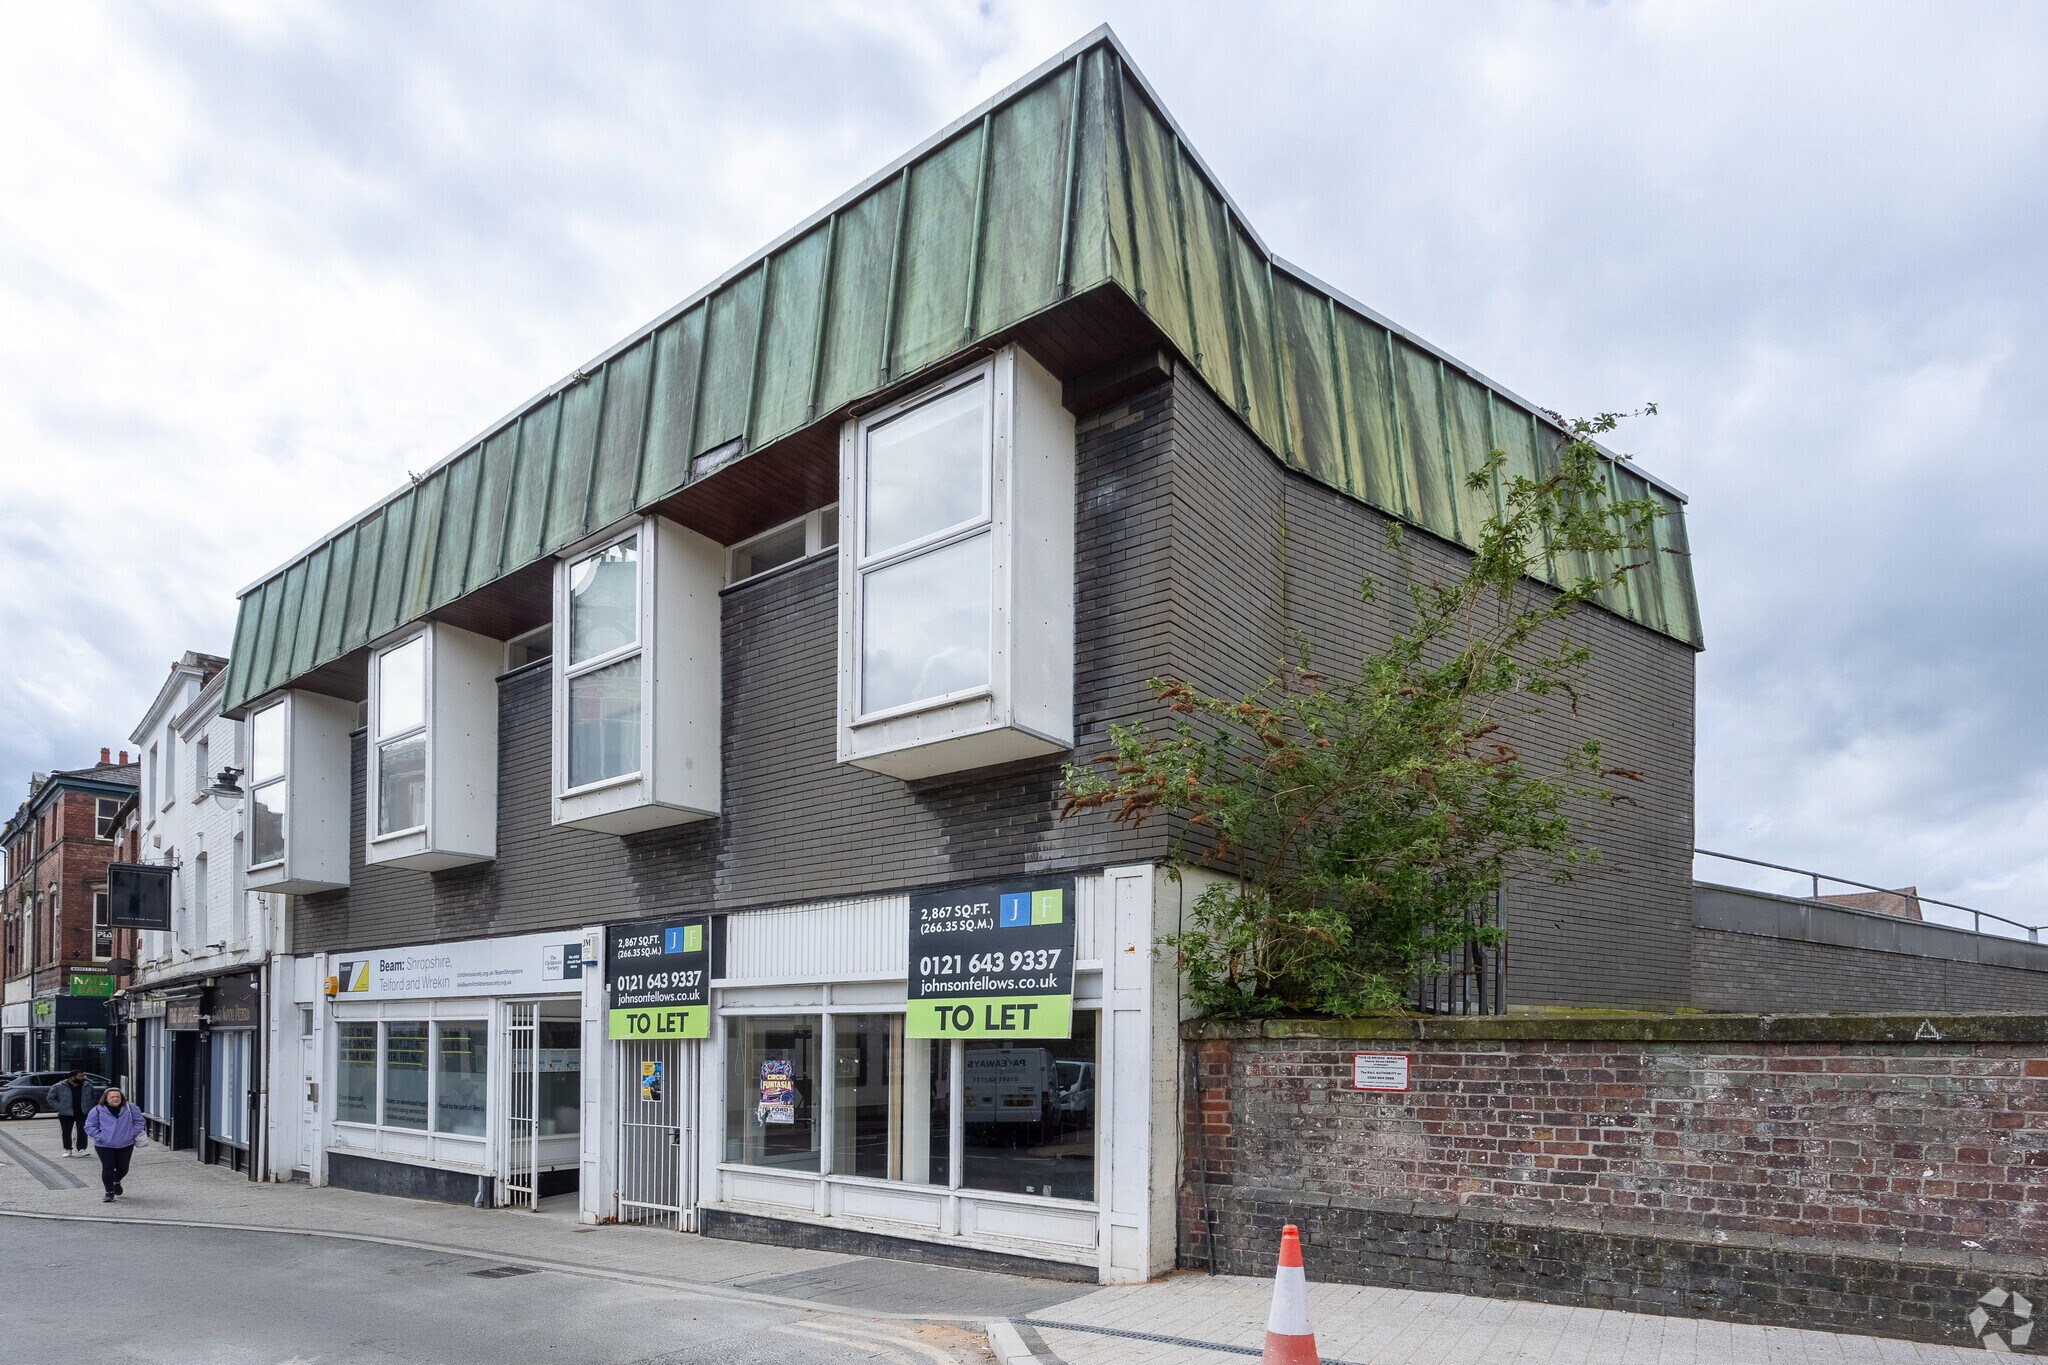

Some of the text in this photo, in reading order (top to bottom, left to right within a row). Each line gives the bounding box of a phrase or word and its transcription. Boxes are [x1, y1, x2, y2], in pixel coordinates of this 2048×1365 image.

[920, 903, 990, 921] 2,867 SQ.FT.
[1009, 896, 1052, 922] J F
[920, 918, 994, 936] (266.35 SQ.M.)
[618, 934, 660, 948] 2,867 SQ.FT.
[670, 930, 696, 950] J F
[618, 946, 662, 960] (266.35 SQ.M.)
[380, 956, 452, 972] Beam: Shropshire,
[920, 949, 1062, 976] 0121 643 9337
[380, 978, 404, 992] Telford
[406, 978, 420, 990] and
[421, 975, 450, 989] Wrekin
[617, 970, 702, 992] 0121 643 9337
[920, 973, 1058, 996] johnsonfellows.co.uk
[618, 989, 700, 1006] johnsonfellows.co.uk
[626, 1012, 689, 1034] TO LET
[934, 1003, 1038, 1032] TO LET
[763, 1081, 792, 1090] FUNTASIA
